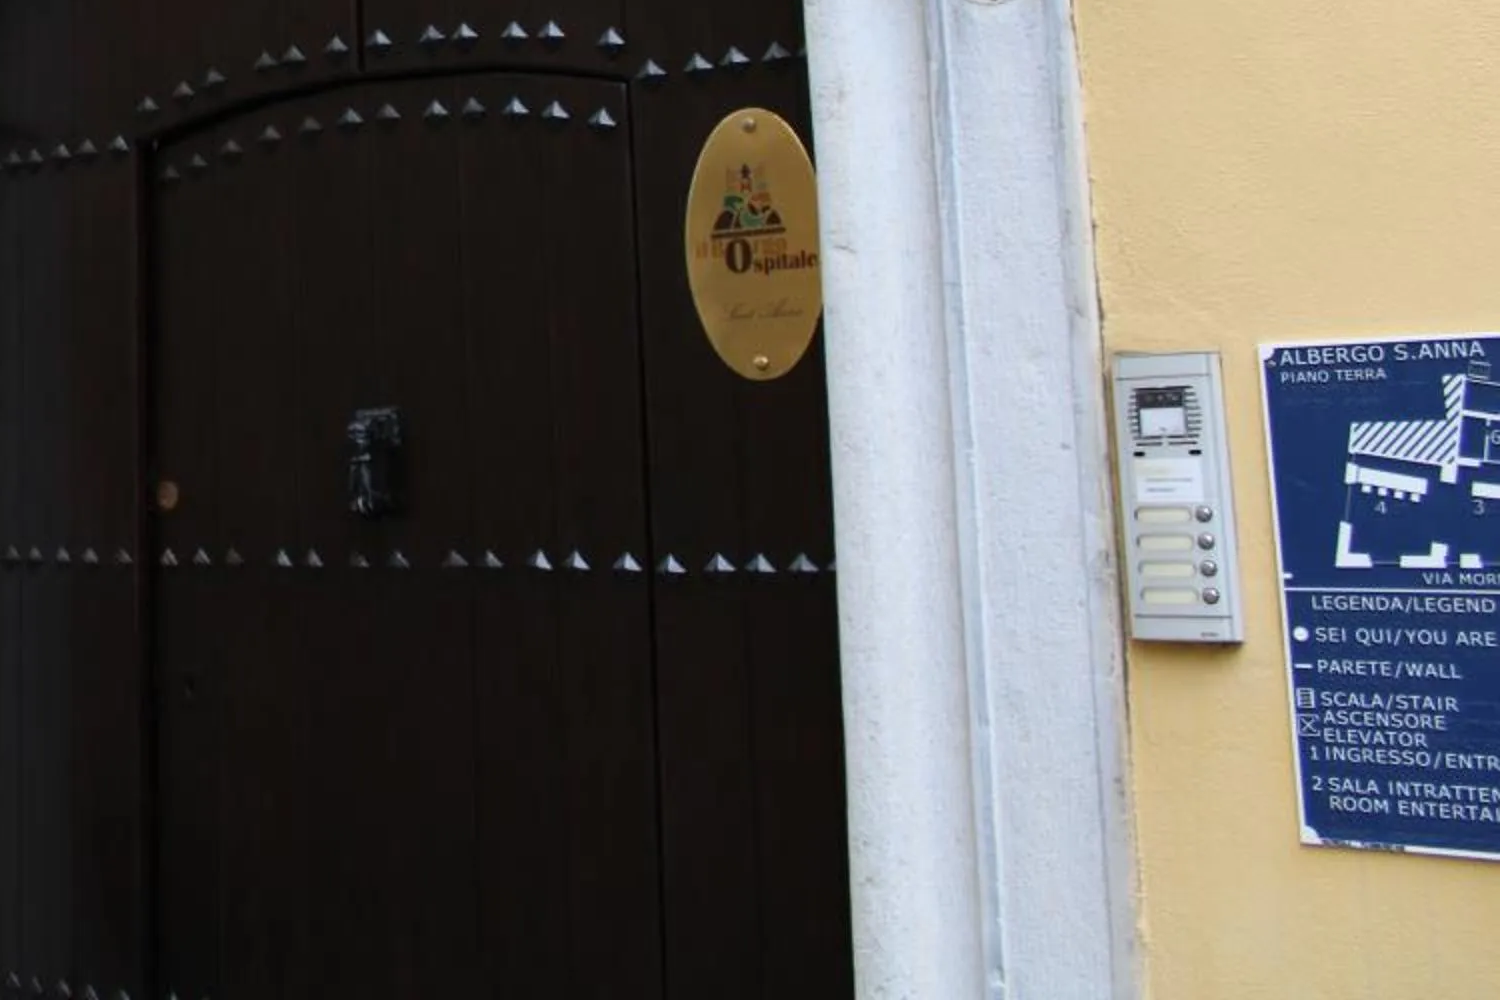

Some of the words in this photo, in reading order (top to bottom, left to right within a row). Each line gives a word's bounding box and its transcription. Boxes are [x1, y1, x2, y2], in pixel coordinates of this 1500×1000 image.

[1280, 345, 1385, 366] ALBERGO
[1394, 340, 1486, 361] S.ANNA
[1280, 369, 1330, 384] PIANO
[1334, 367, 1387, 382] TERRA
[1374, 501, 1388, 515] 4
[1473, 501, 1486, 515] 3
[1422, 572, 1453, 585] VIA
[1459, 572, 1500, 586] MOR
[1311, 594, 1496, 614] LEGENDA/LEGEND
[1315, 626, 1347, 642] SEI
[1355, 627, 1448, 647] QUI/YOU
[1455, 630, 1499, 647] ARE
[1317, 659, 1463, 680] PARETE/WALL
[1320, 691, 1460, 713] SCALA/STAIR
[1323, 709, 1448, 731] ASCENSORE
[1323, 727, 1428, 748] ELEVATOR
[1310, 745, 1320, 761] 1
[1311, 775, 1323, 791] 2
[1328, 777, 1380, 796] SALA
[1329, 795, 1390, 815] ROOM
